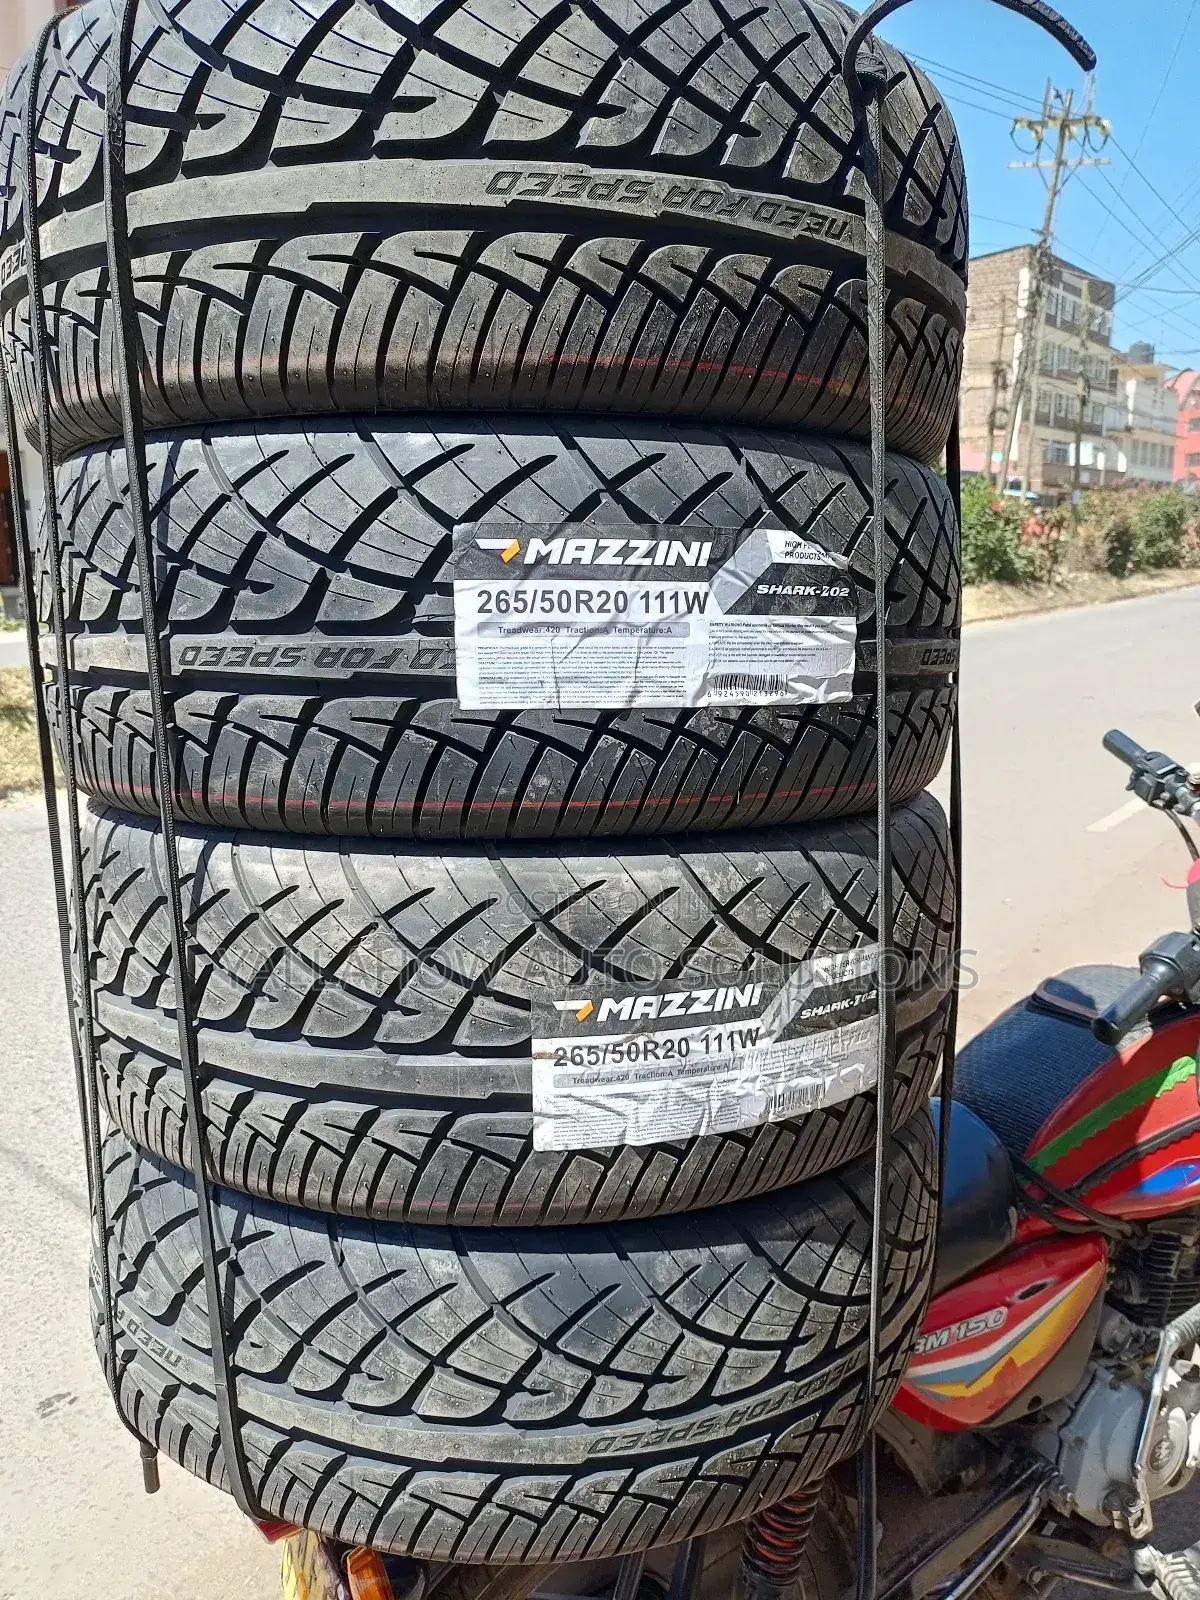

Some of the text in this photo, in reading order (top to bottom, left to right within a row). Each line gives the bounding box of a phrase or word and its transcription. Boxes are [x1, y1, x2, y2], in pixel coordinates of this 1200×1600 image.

[485, 171, 849, 241] NEED FOR SPEED
[523, 538, 713, 567] MAZZINI
[477, 589, 710, 614] 265/50R20 111W
[498, 626, 672, 636] Treadwear:420 Traction:A Temperature:A
[178, 646, 306, 667] SPEED
[314, 647, 405, 670] FOR
[597, 982, 764, 1022] MAZZINI
[554, 1037, 690, 1067] 265/50R20
[701, 1027, 760, 1055] 111W
[573, 1062, 729, 1084] Treadwear:420 Traction:A Temperature:A
[956, 1309, 1006, 1341] 150
[127, 1318, 182, 1368] NEED
[587, 1415, 721, 1454] SPEED
